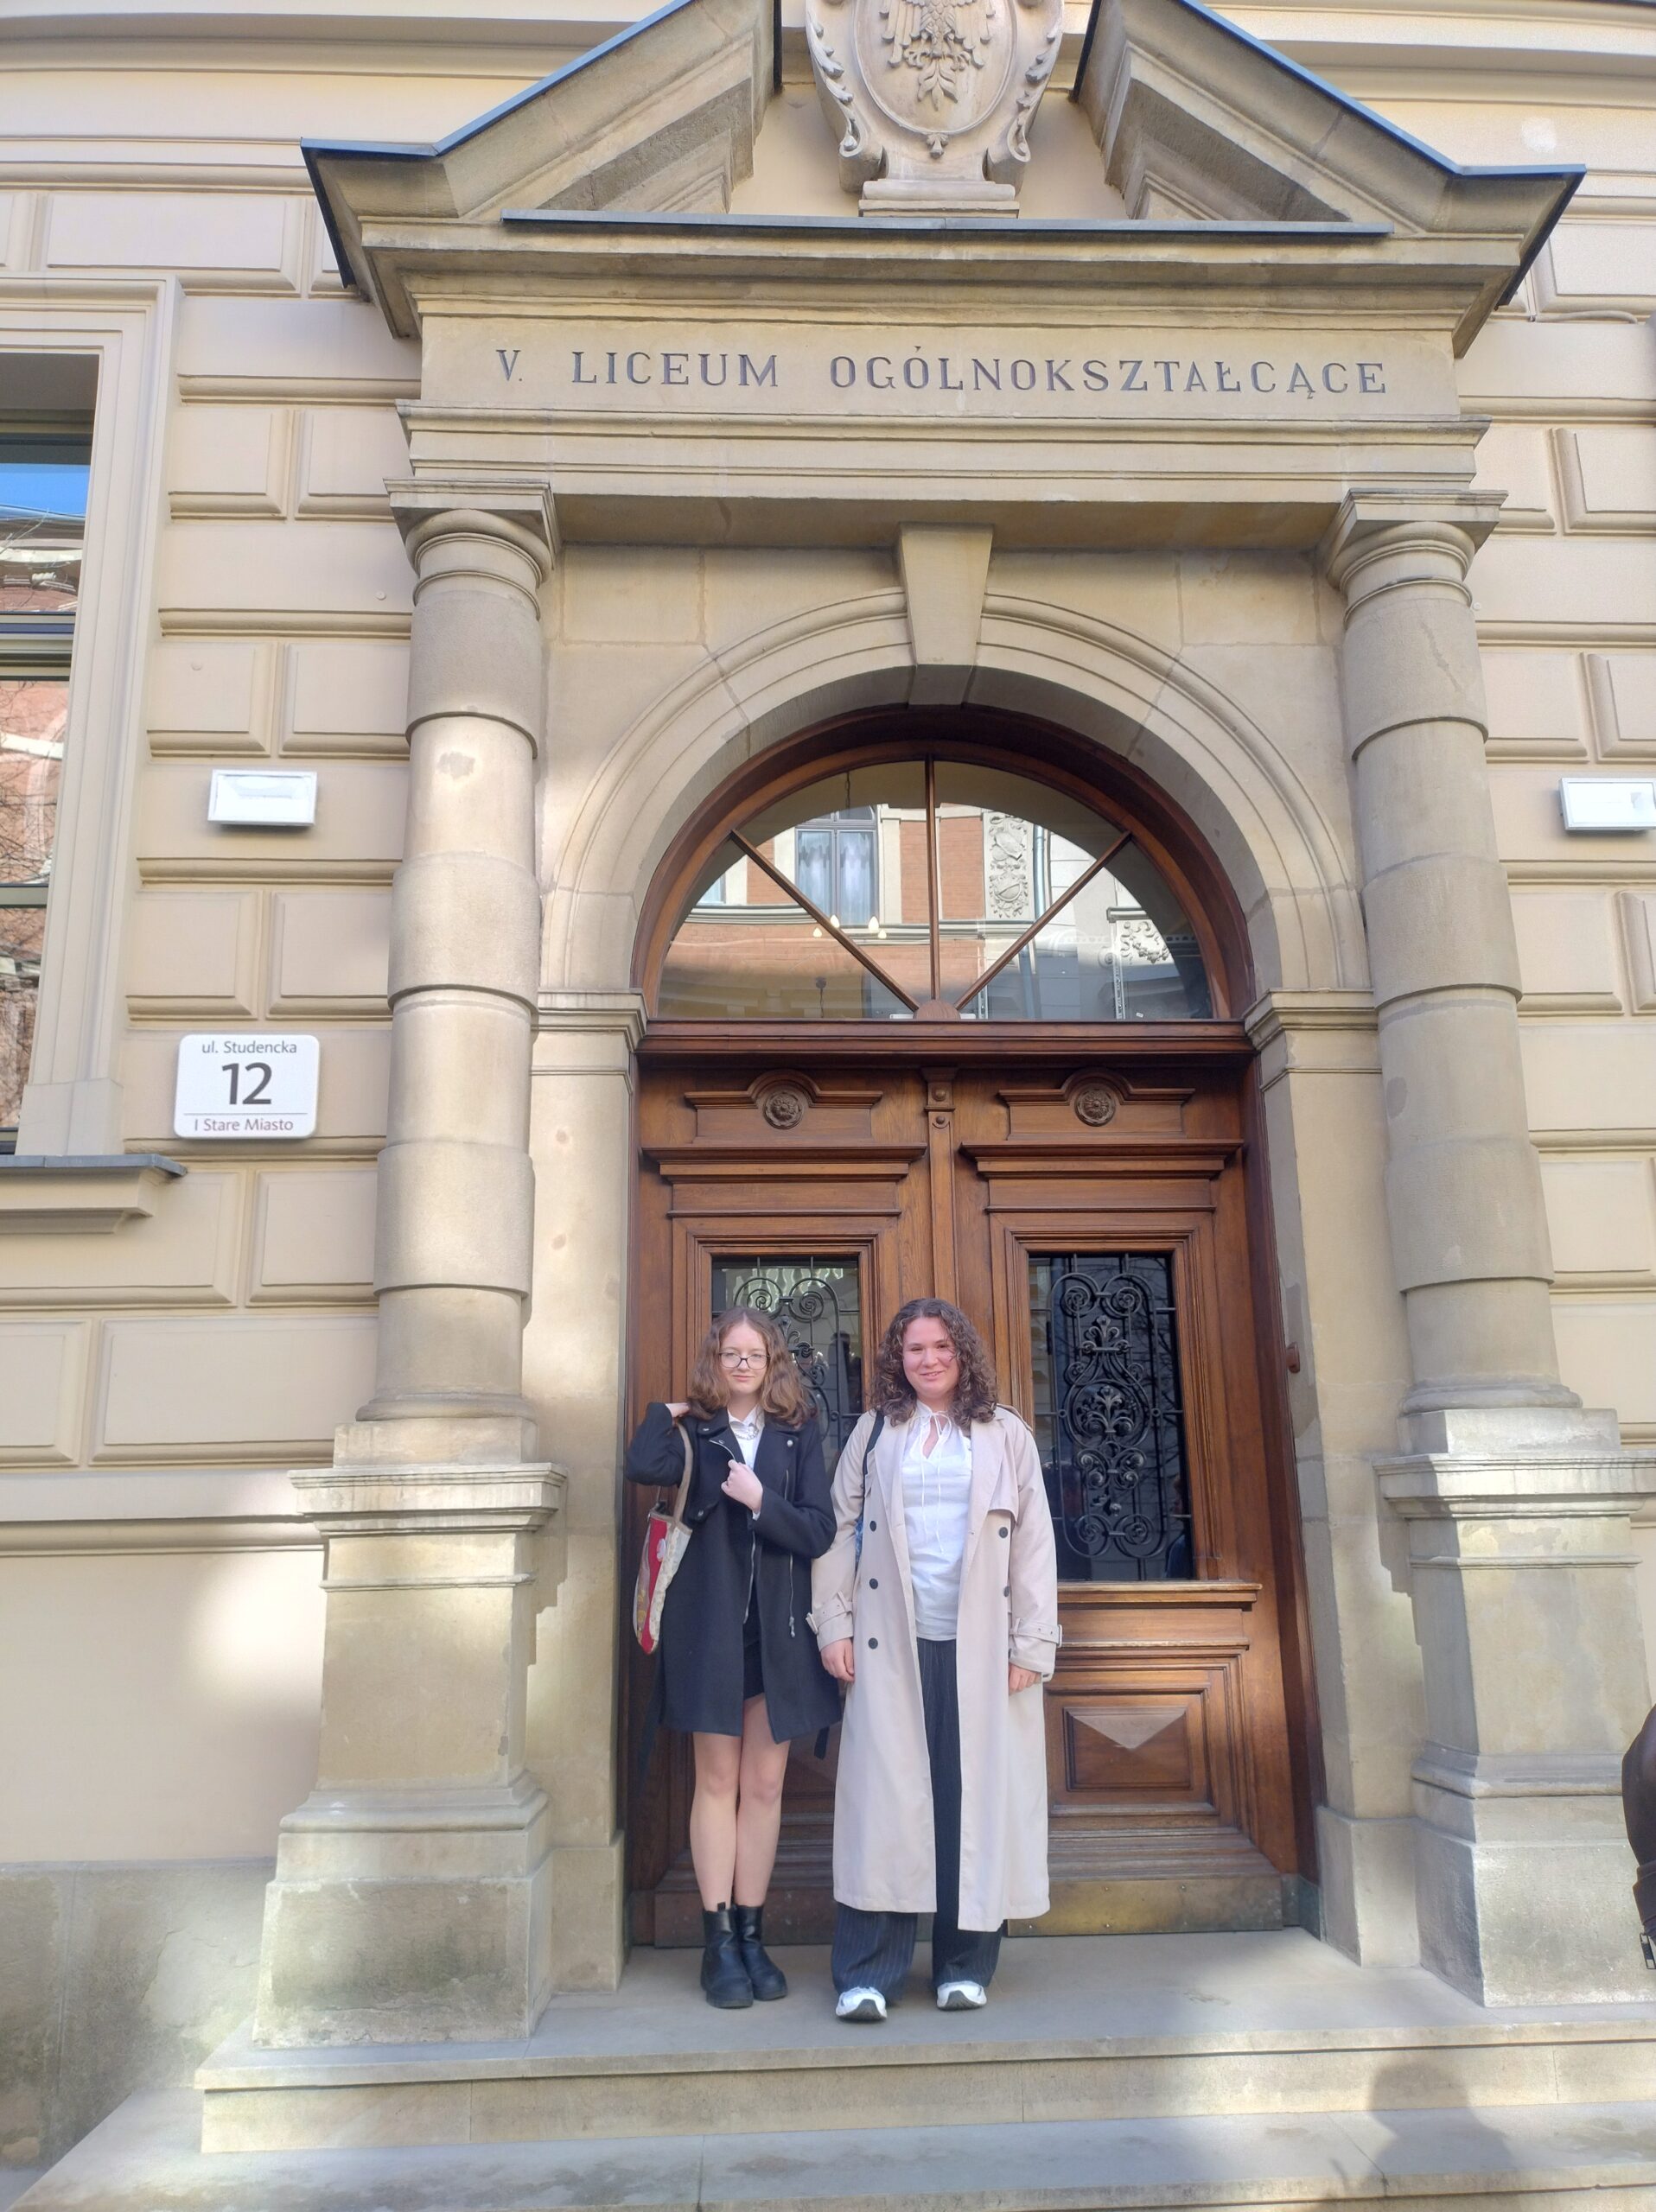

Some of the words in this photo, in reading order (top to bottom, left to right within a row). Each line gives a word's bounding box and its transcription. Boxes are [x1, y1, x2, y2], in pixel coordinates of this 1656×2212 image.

[571, 351, 779, 388] LICEUM
[829, 346, 1386, 400] OGÓLNOKSZTAŁCĄCE
[201, 1040, 219, 1054] ul.
[223, 1040, 297, 1054] Studencka
[221, 1062, 272, 1105] 12
[203, 1118, 240, 1132] Stare
[245, 1118, 294, 1132] Miasto
